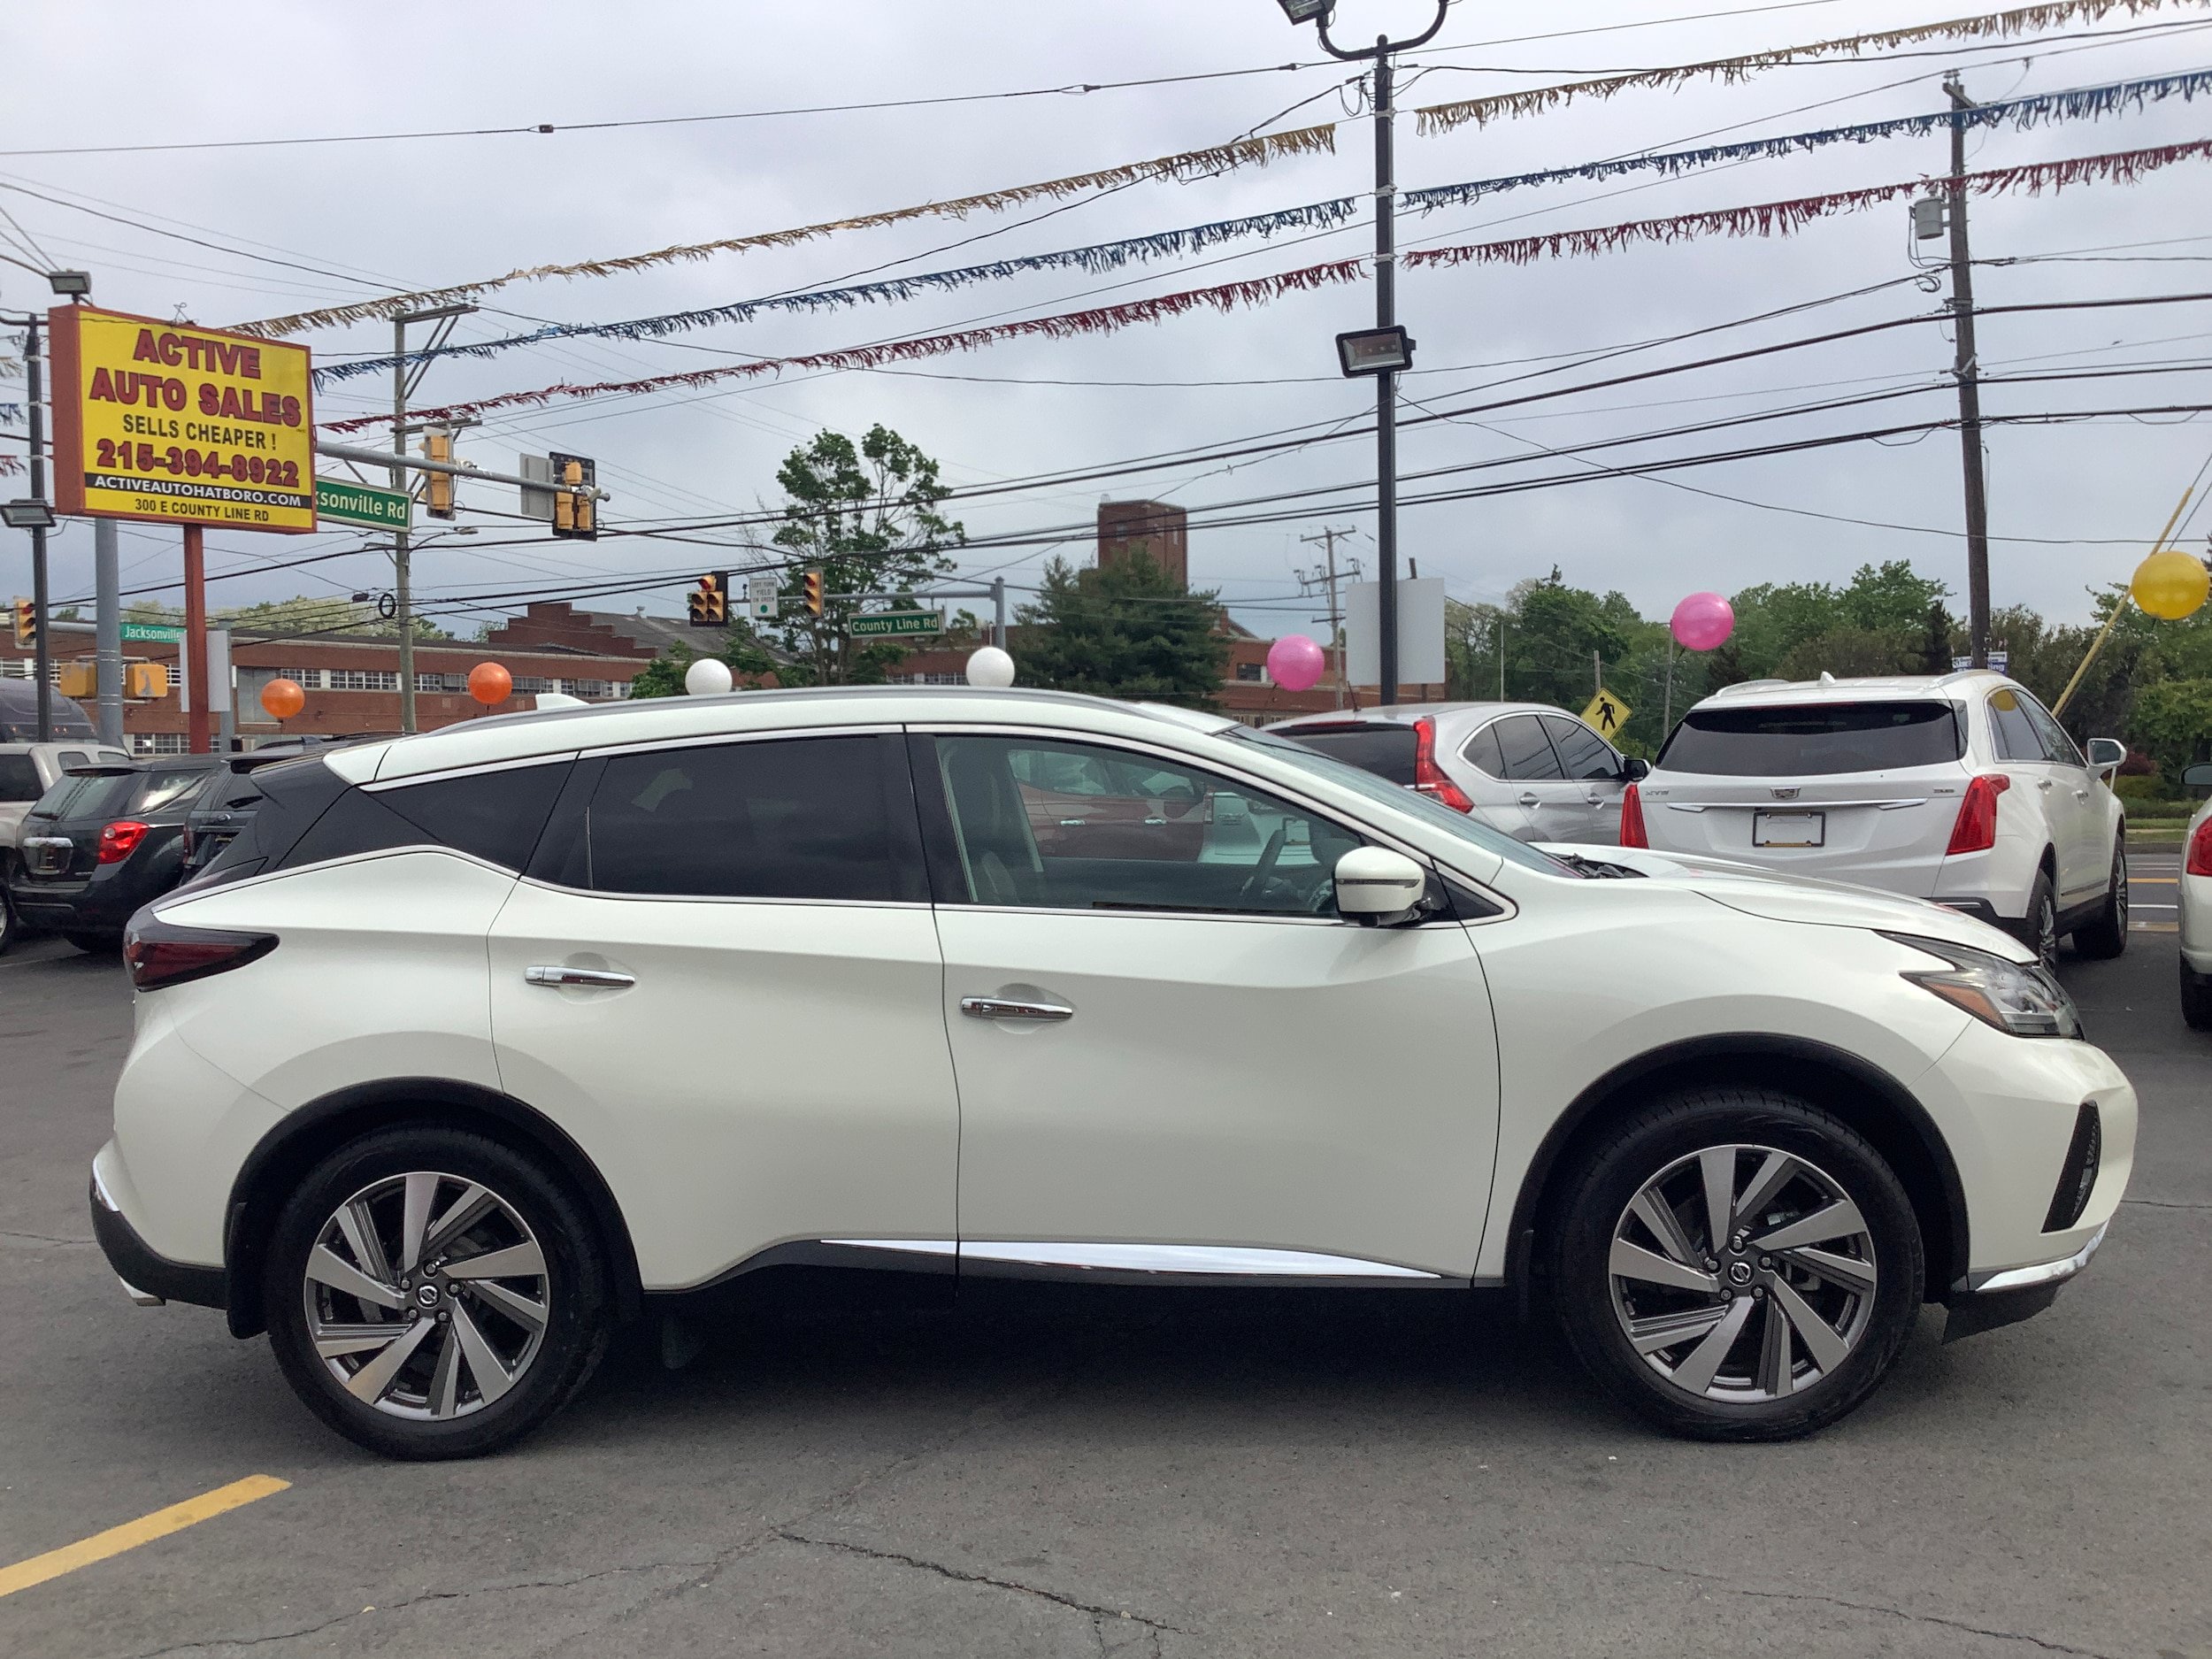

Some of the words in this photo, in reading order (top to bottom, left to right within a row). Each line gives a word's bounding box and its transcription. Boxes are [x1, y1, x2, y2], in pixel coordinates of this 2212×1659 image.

[133, 328, 261, 380] ACTIVE
[88, 367, 188, 412] AUTO
[198, 383, 302, 428] SALES
[123, 413, 179, 439] SELLS
[186, 422, 266, 450] CHEAPER
[96, 438, 300, 488] 215-394-8922
[95, 476, 301, 508] ACTIVEAUTOHATBORO.COM
[135, 498, 157, 512] 300
[160, 501, 167, 513] E
[172, 502, 220, 518] COUNTY
[225, 506, 250, 520] LINE
[254, 510, 269, 522] RD
[387, 502, 406, 519] Rd
[852, 620, 893, 633] County
[895, 618, 920, 630] Line
[923, 617, 938, 629] Rd
